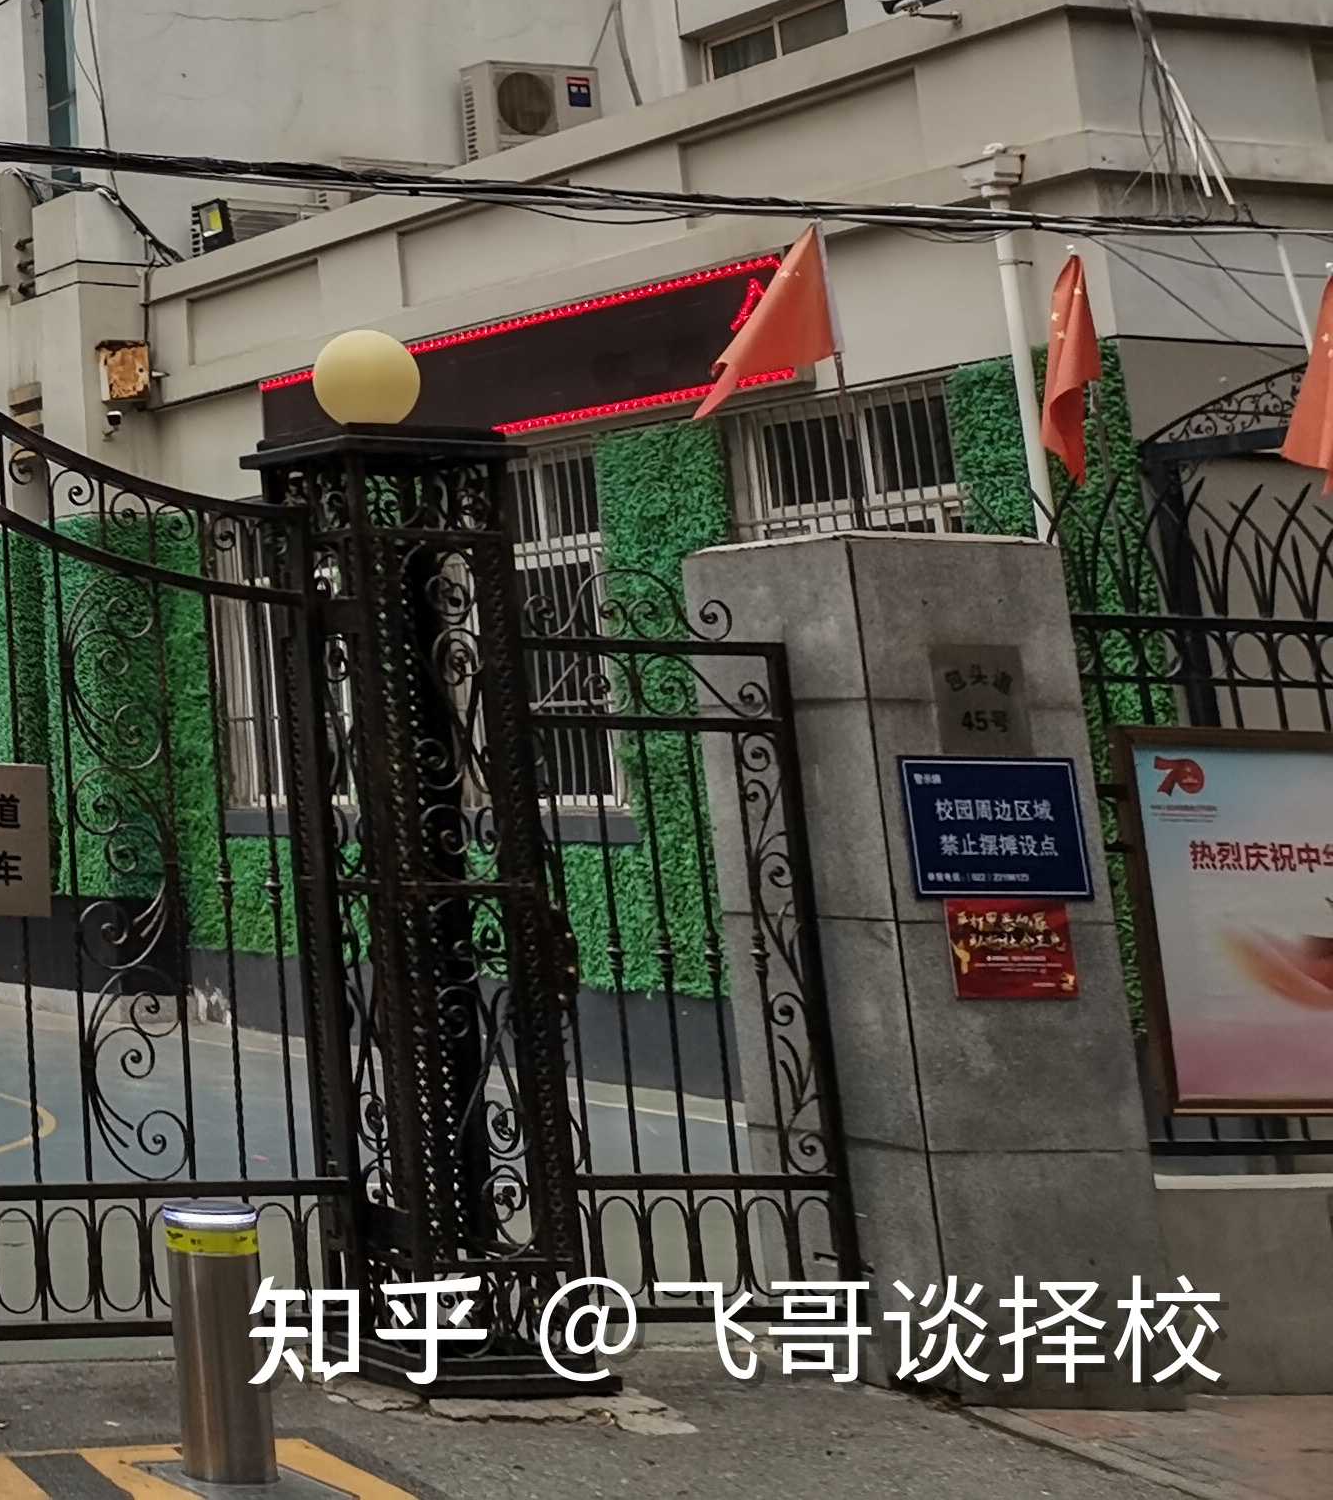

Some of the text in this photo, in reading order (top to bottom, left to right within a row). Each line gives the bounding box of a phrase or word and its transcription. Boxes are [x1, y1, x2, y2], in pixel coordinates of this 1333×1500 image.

[961, 710, 1008, 733] 45号
[935, 798, 1055, 822] 校园周边区域
[939, 832, 1060, 857] 禁止摆摊设点
